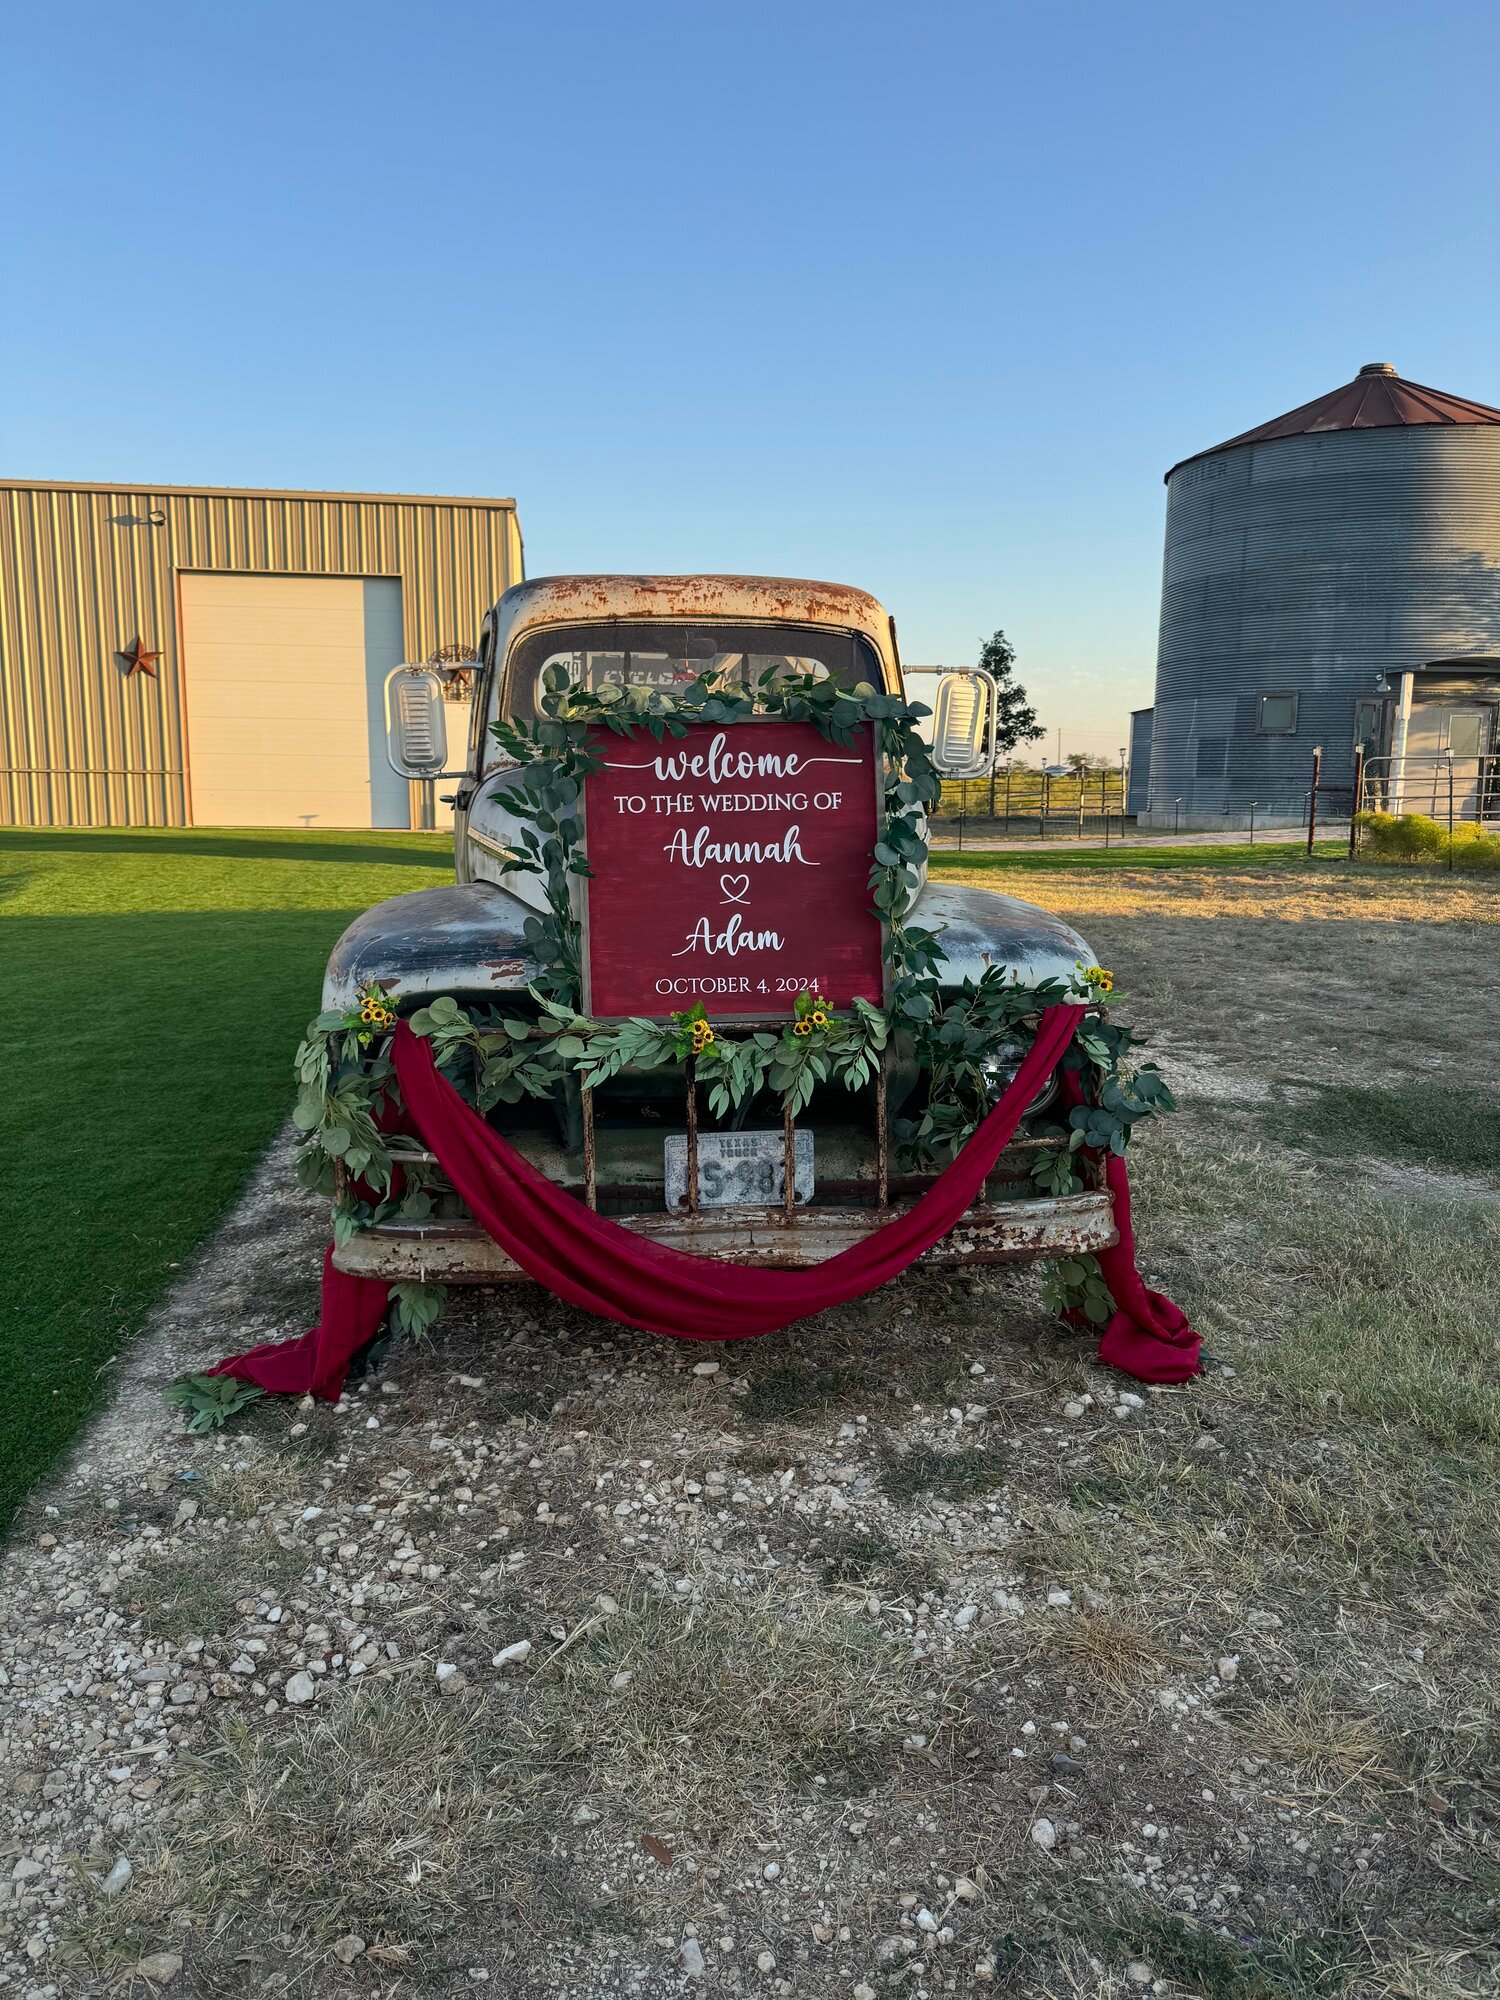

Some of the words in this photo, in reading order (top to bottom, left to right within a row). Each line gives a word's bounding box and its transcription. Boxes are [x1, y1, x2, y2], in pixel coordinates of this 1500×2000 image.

[604, 670, 678, 686] CYCLO
[604, 732, 863, 784] welcome
[613, 795, 647, 814] TO
[650, 792, 695, 816] THE
[698, 792, 809, 812] WEDDING
[813, 792, 842, 810] OF
[663, 824, 821, 869] Alannah
[671, 913, 786, 957] Adam
[655, 977, 752, 994] OCTOBER
[756, 978, 771, 994] 4,
[775, 977, 820, 993] 2024
[719, 1137, 758, 1149] TEXAS
[719, 1148, 758, 1158] TRUCK
